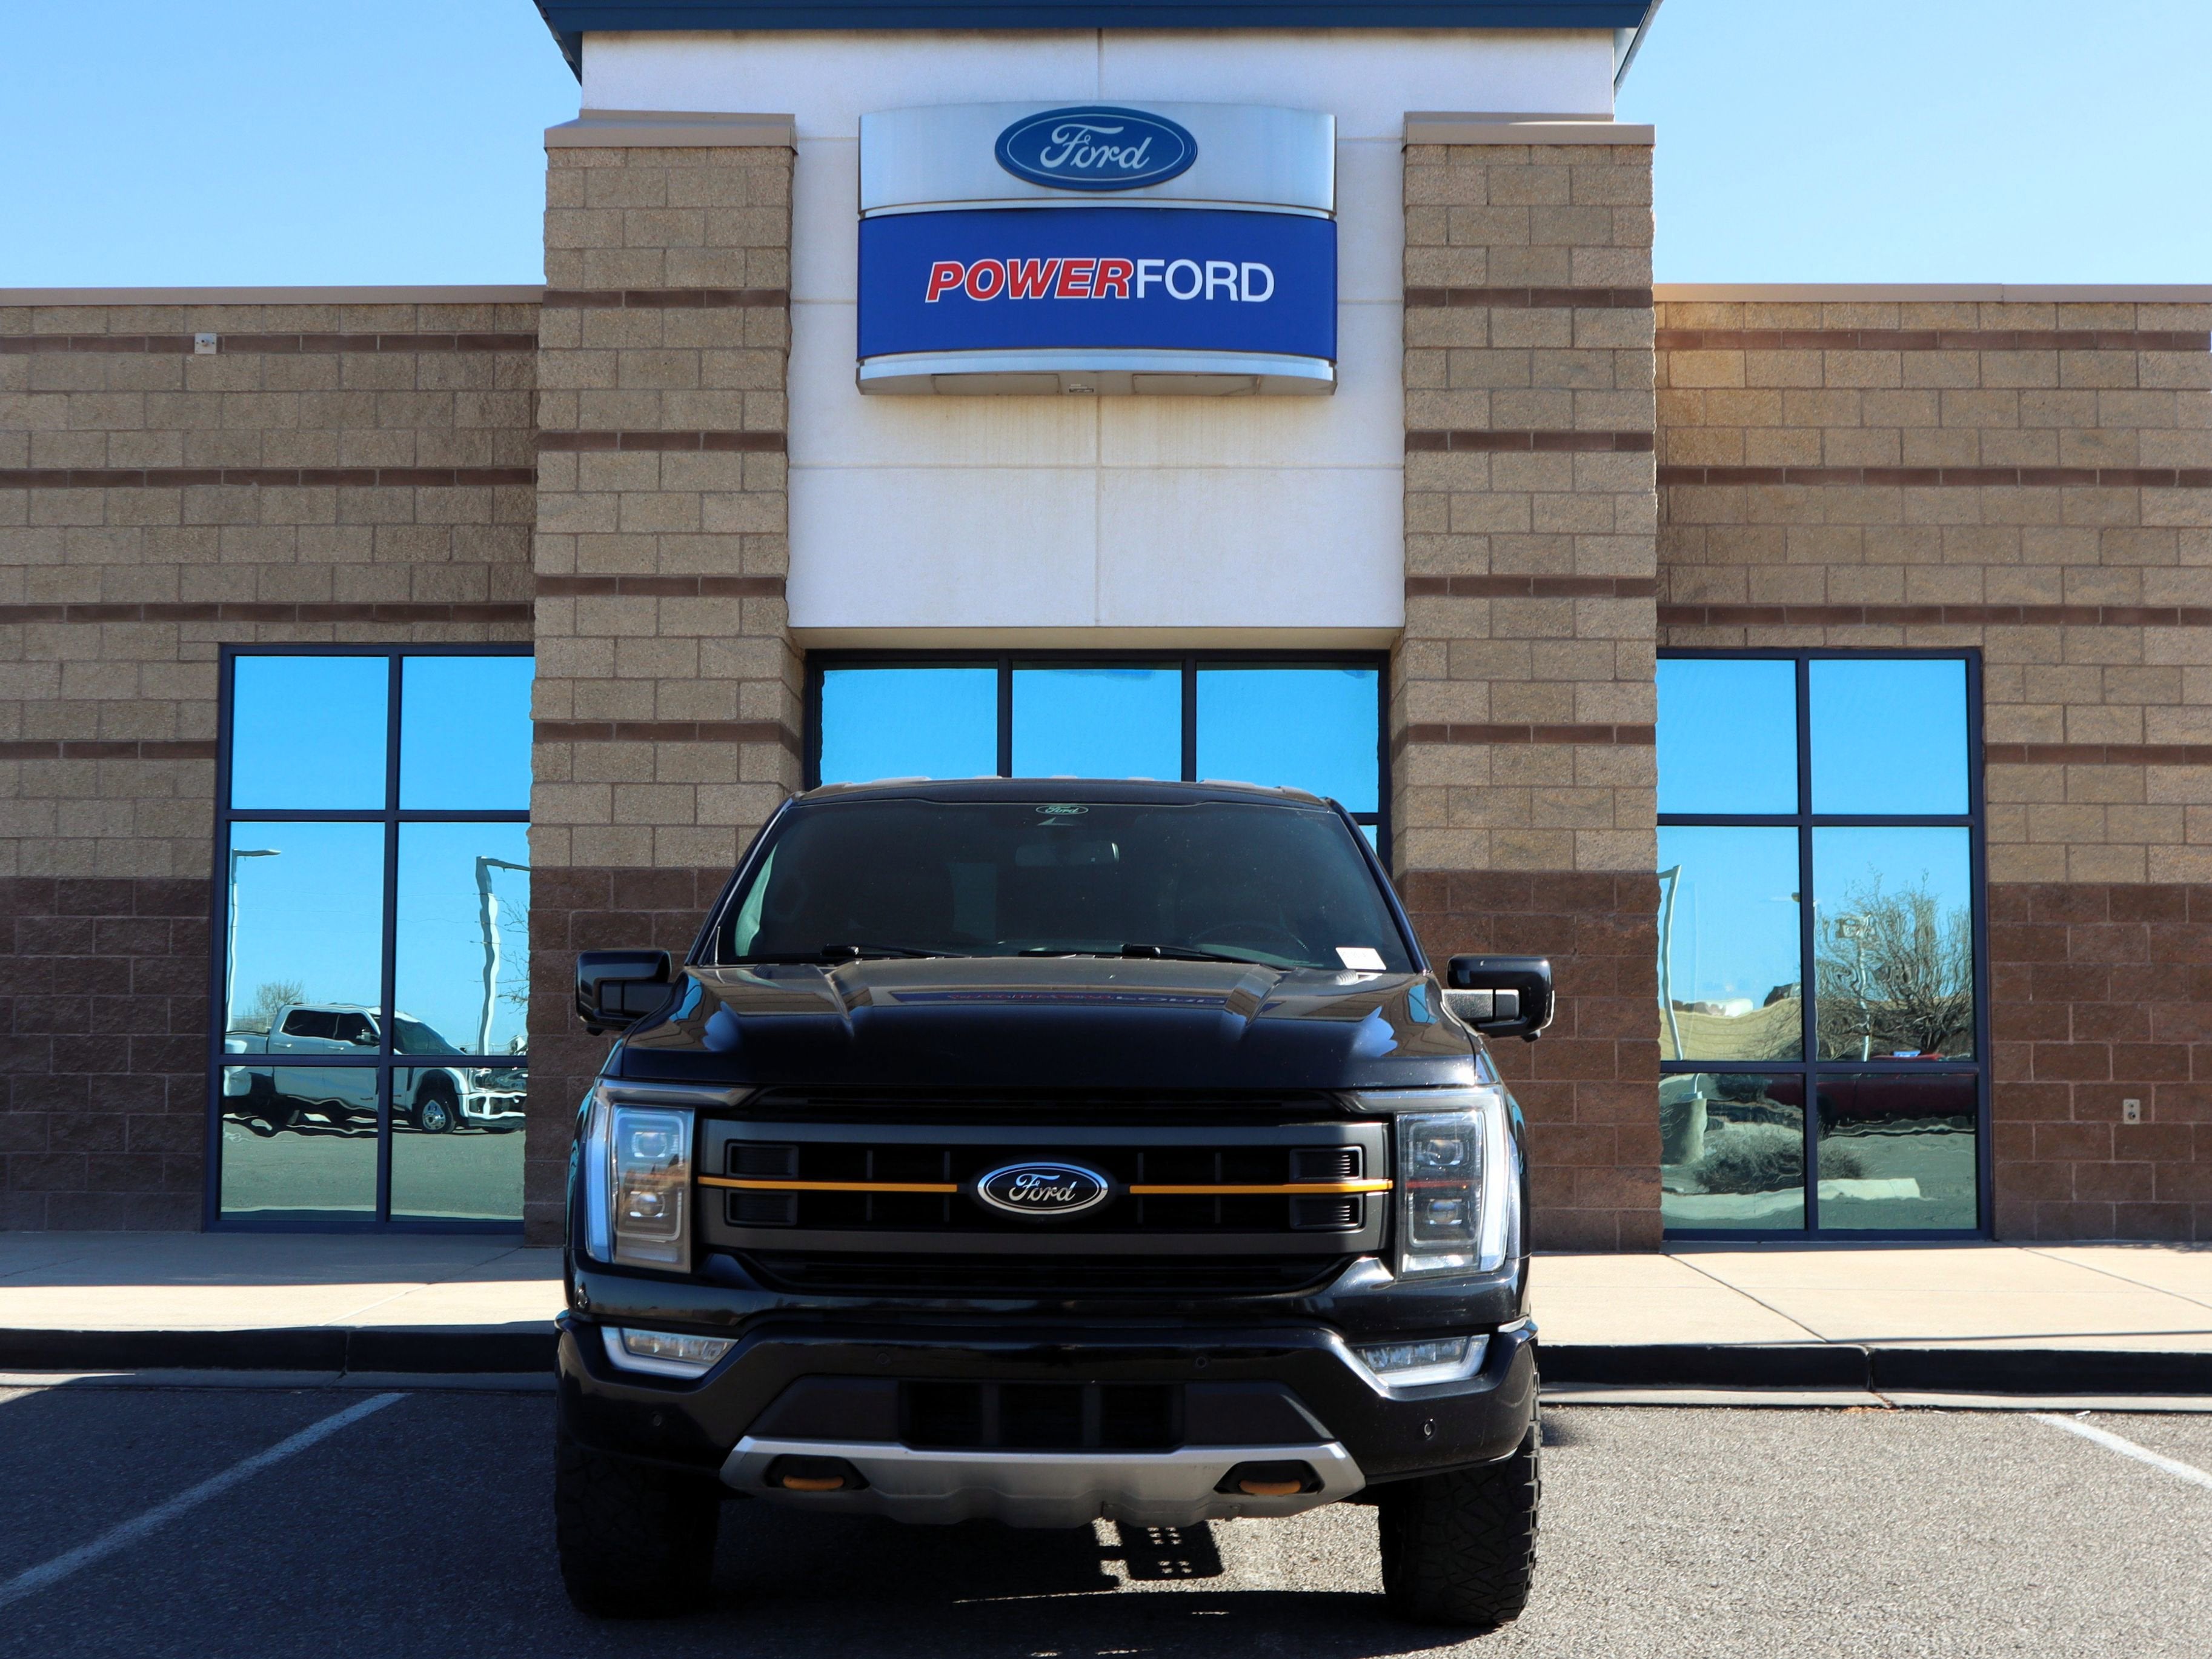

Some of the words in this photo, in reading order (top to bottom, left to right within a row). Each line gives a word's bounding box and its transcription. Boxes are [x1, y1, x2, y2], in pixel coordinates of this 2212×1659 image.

[1040, 124, 1152, 168] Ford
[1045, 805, 1079, 813] Ford
[1009, 1173, 1077, 1201] Ford
